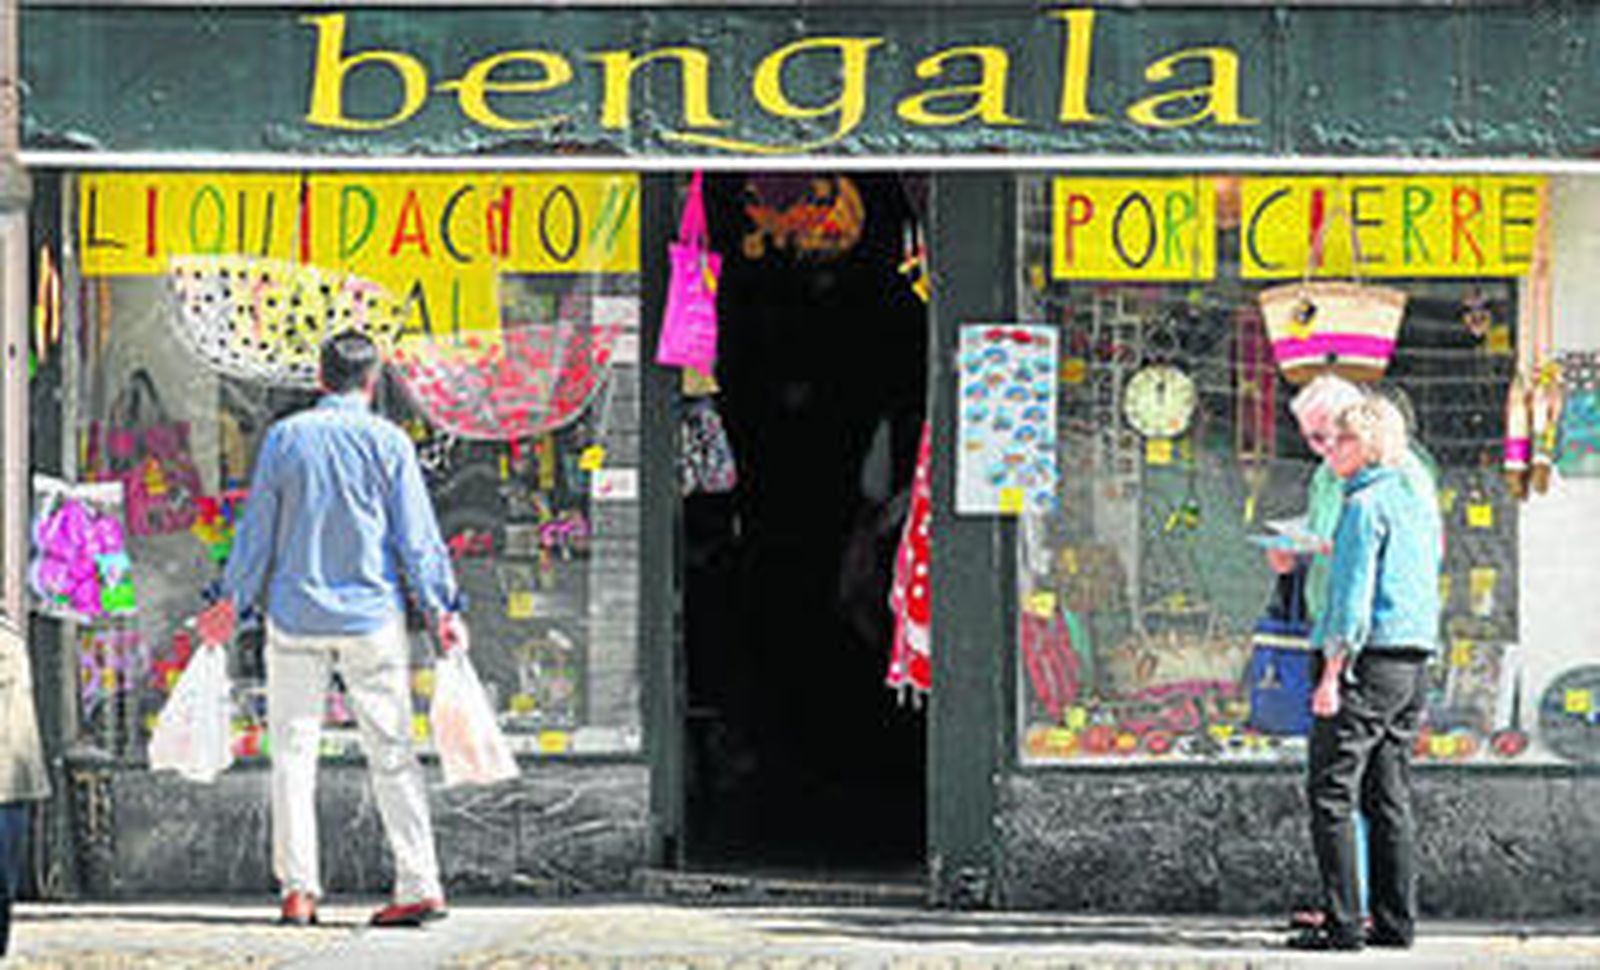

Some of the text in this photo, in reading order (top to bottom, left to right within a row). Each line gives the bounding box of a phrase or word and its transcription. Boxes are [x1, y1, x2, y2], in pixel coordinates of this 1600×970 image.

[303, 9, 1258, 153] bengala
[1064, 185, 1535, 270] POR CIERRE
